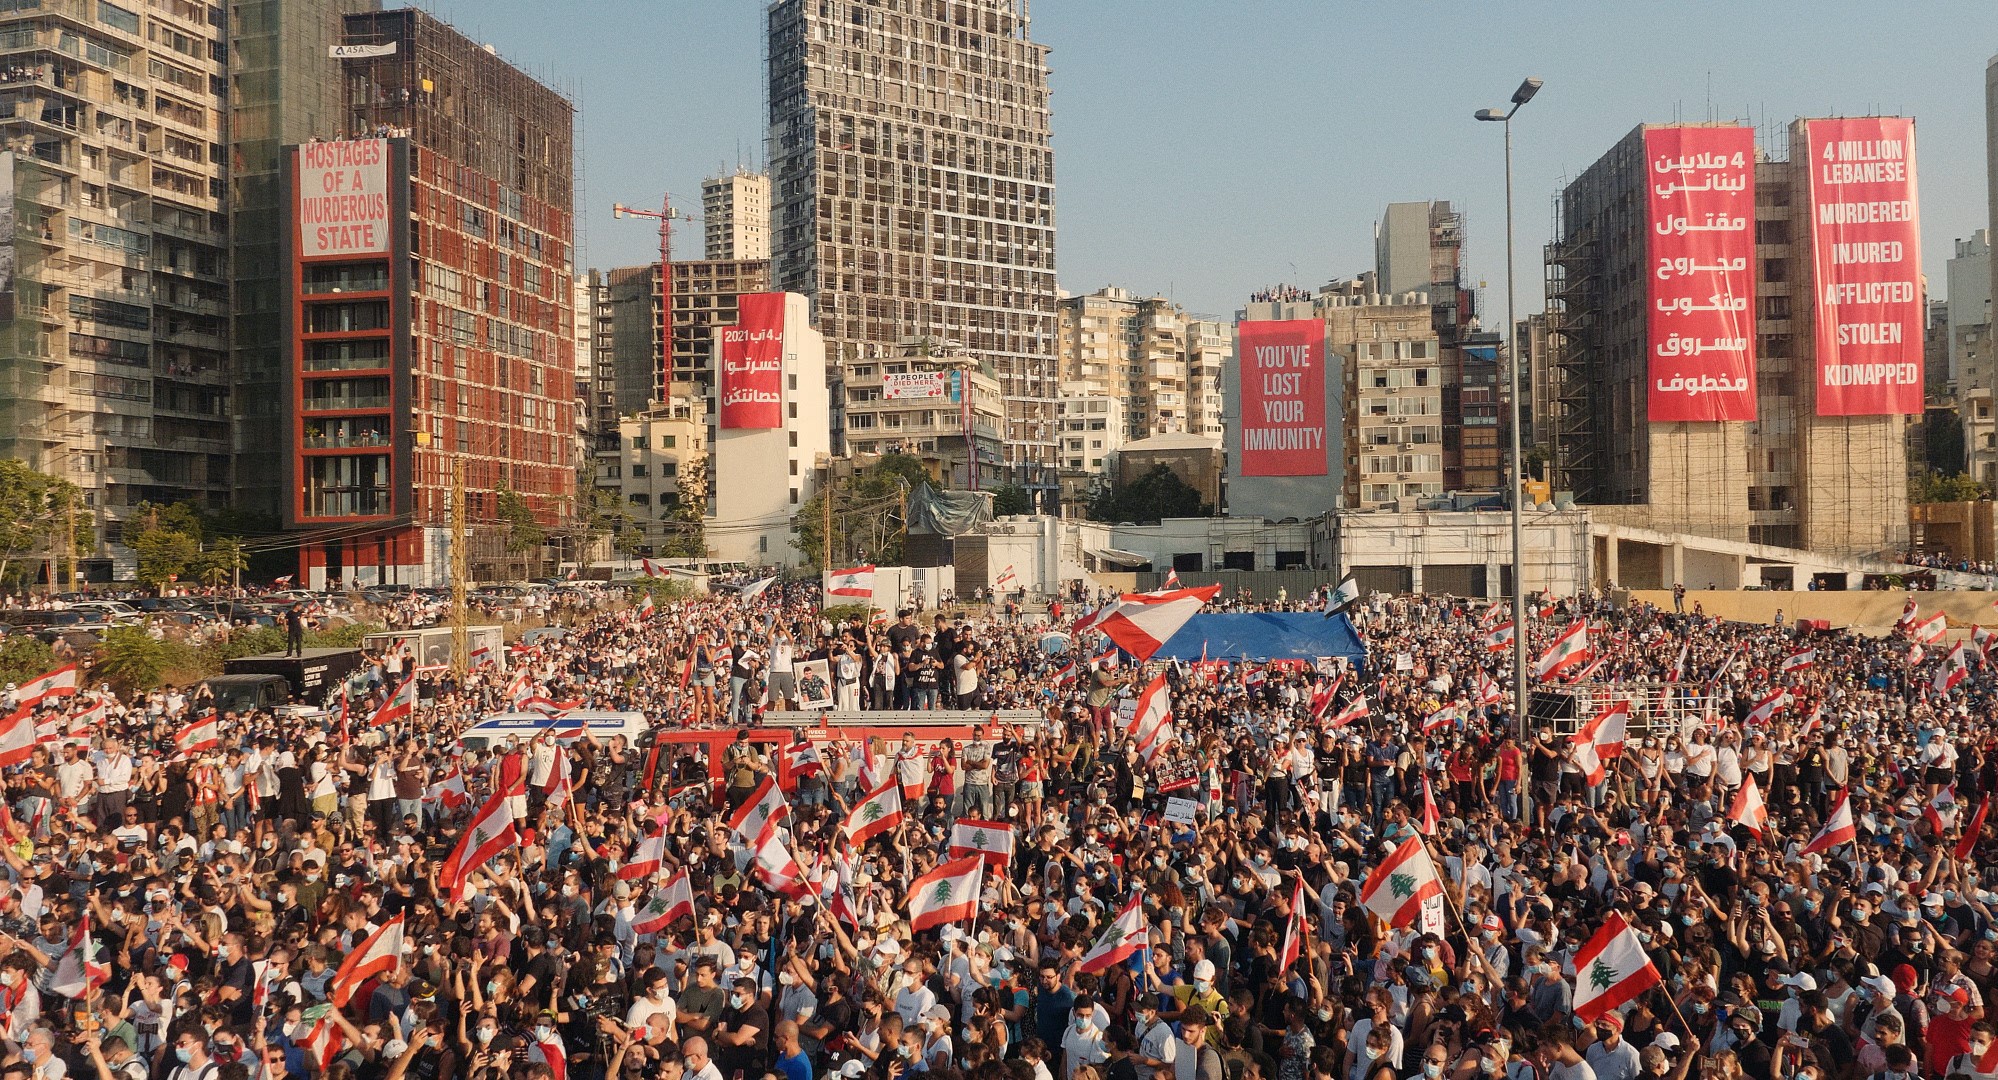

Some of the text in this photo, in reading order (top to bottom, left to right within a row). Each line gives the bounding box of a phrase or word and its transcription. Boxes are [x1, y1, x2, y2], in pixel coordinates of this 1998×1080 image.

[305, 138, 380, 169] HOSTAGES
[1823, 139, 1903, 161] 4 MILLION
[1654, 151, 1745, 174] 4 ملايين
[1823, 161, 1905, 185] LEBANESE
[323, 169, 364, 193] OF A
[1655, 172, 1746, 199] لبناني
[303, 192, 385, 224] MURDEROUS
[1819, 200, 1912, 225] MURDERED
[1656, 212, 1746, 236] مقتول
[316, 224, 375, 250] STATE
[1832, 241, 1903, 265] INJURED
[1656, 257, 1746, 280] مجروح
[1656, 292, 1747, 316] منكوب
[1825, 281, 1914, 305] AFFLICTED
[724, 329, 749, 342] 2021
[750, 329, 766, 344] آب
[766, 329, 773, 341] 4
[1656, 332, 1747, 357] مسروق
[1838, 322, 1902, 345] STOLEN
[1255, 344, 1311, 368] YOU'VE
[1263, 372, 1302, 396] LOST
[1656, 372, 1748, 397] مخطوف
[1824, 362, 1918, 386] KIDNAPPED
[1263, 400, 1304, 423] YOUR
[1244, 427, 1323, 451] IMMUNITY
